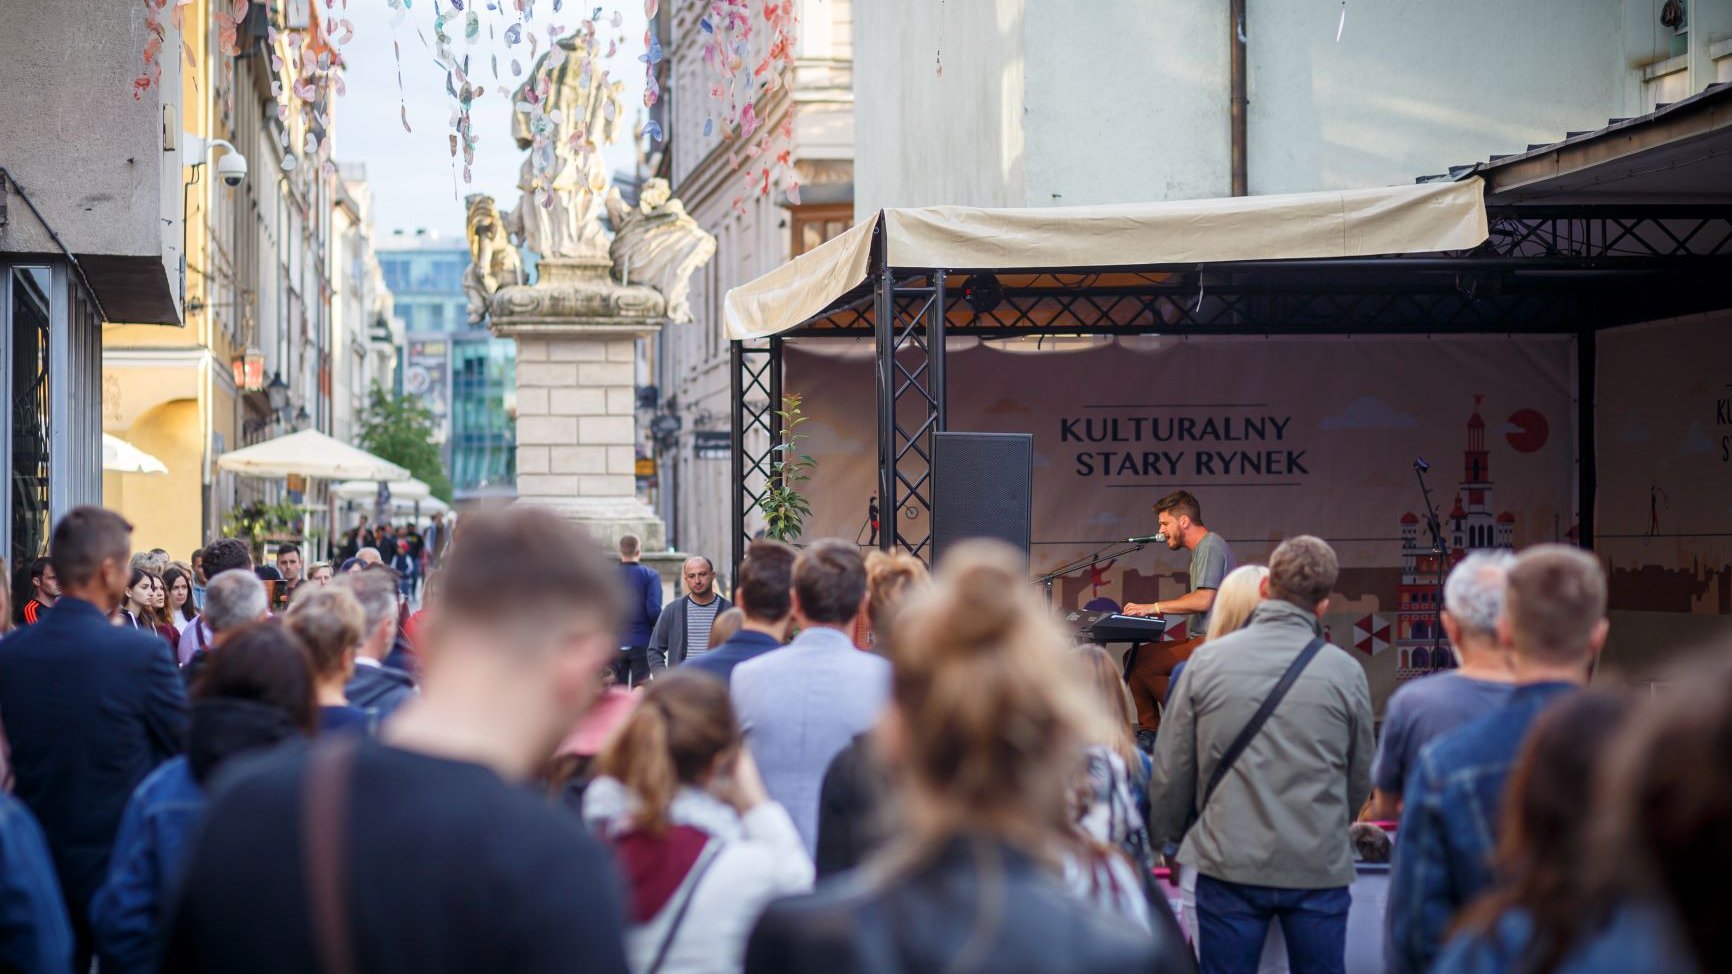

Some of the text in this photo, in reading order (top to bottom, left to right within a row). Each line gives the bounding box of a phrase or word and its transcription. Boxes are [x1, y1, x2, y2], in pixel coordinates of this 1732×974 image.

[1061, 416, 1291, 442] KULTURALNY
[1076, 450, 1309, 476] STARY RYNEK
